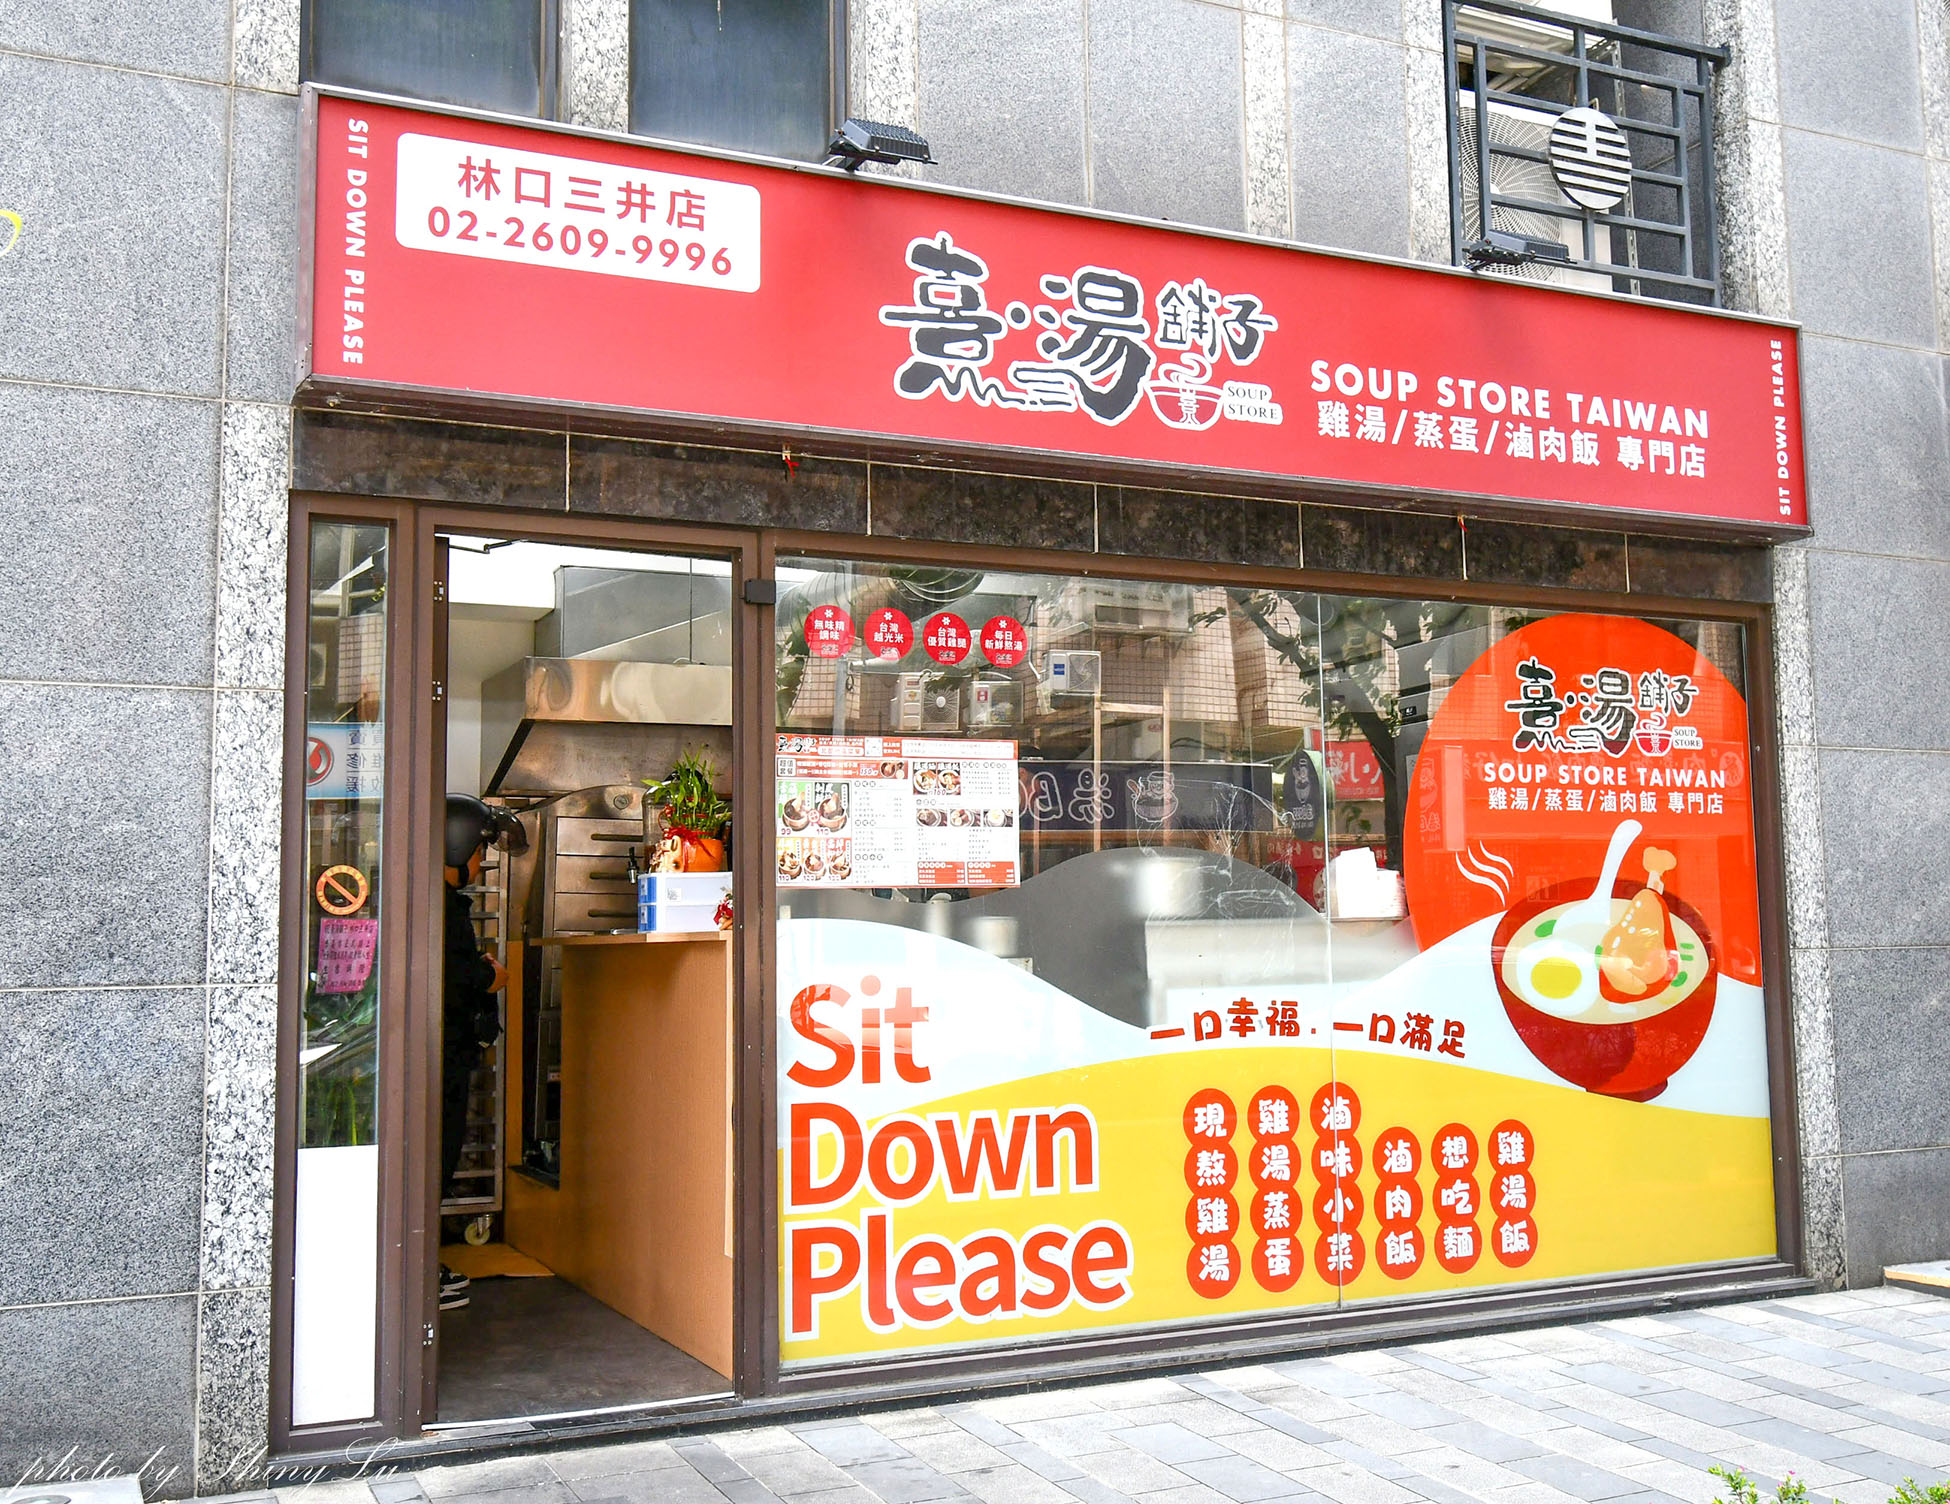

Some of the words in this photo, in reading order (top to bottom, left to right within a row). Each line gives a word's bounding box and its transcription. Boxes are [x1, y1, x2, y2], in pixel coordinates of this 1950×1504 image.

[348, 118, 369, 159] SIT
[345, 170, 368, 257] DOWN
[458, 156, 706, 232] 林口三井店
[427, 206, 733, 276] 02-2609-9996
[342, 269, 366, 365] PLEASE
[1227, 385, 1268, 401] SOUP
[1310, 360, 1418, 401] SOUP
[1437, 376, 1550, 419] STORE
[1566, 393, 1709, 439] TAIWAN
[1770, 339, 1784, 407] PLEASE
[1228, 404, 1278, 420] STORE
[1617, 436, 1706, 478] 專門店
[1776, 416, 1788, 479] DOWN
[1779, 486, 1791, 516] SIT
[814, 619, 845, 631] 無味精
[873, 631, 904, 643] 越光米
[879, 622, 899, 633] 台灣
[938, 627, 957, 638] 台灣
[994, 630, 1013, 641] 每日
[1674, 728, 1696, 737] SOUP
[1674, 738, 1701, 748] STORE
[1484, 762, 1547, 783] SOUP
[1558, 765, 1626, 786] STORE
[1637, 767, 1726, 788] TAIWAN
[1668, 792, 1724, 815] 專門店
[786, 974, 932, 1088] Sit
[790, 1102, 1094, 1207] Down
[1320, 1096, 1354, 1272] 滷味小菜
[1193, 1102, 1229, 1282] 現熬雞湯
[1258, 1098, 1292, 1277] 雞湯蒸蛋
[1382, 1139, 1417, 1266] 滷肉飯
[1441, 1135, 1474, 1260] 想吃麵
[1497, 1131, 1530, 1254] 雞湯飯
[791, 1214, 1129, 1334] Please
